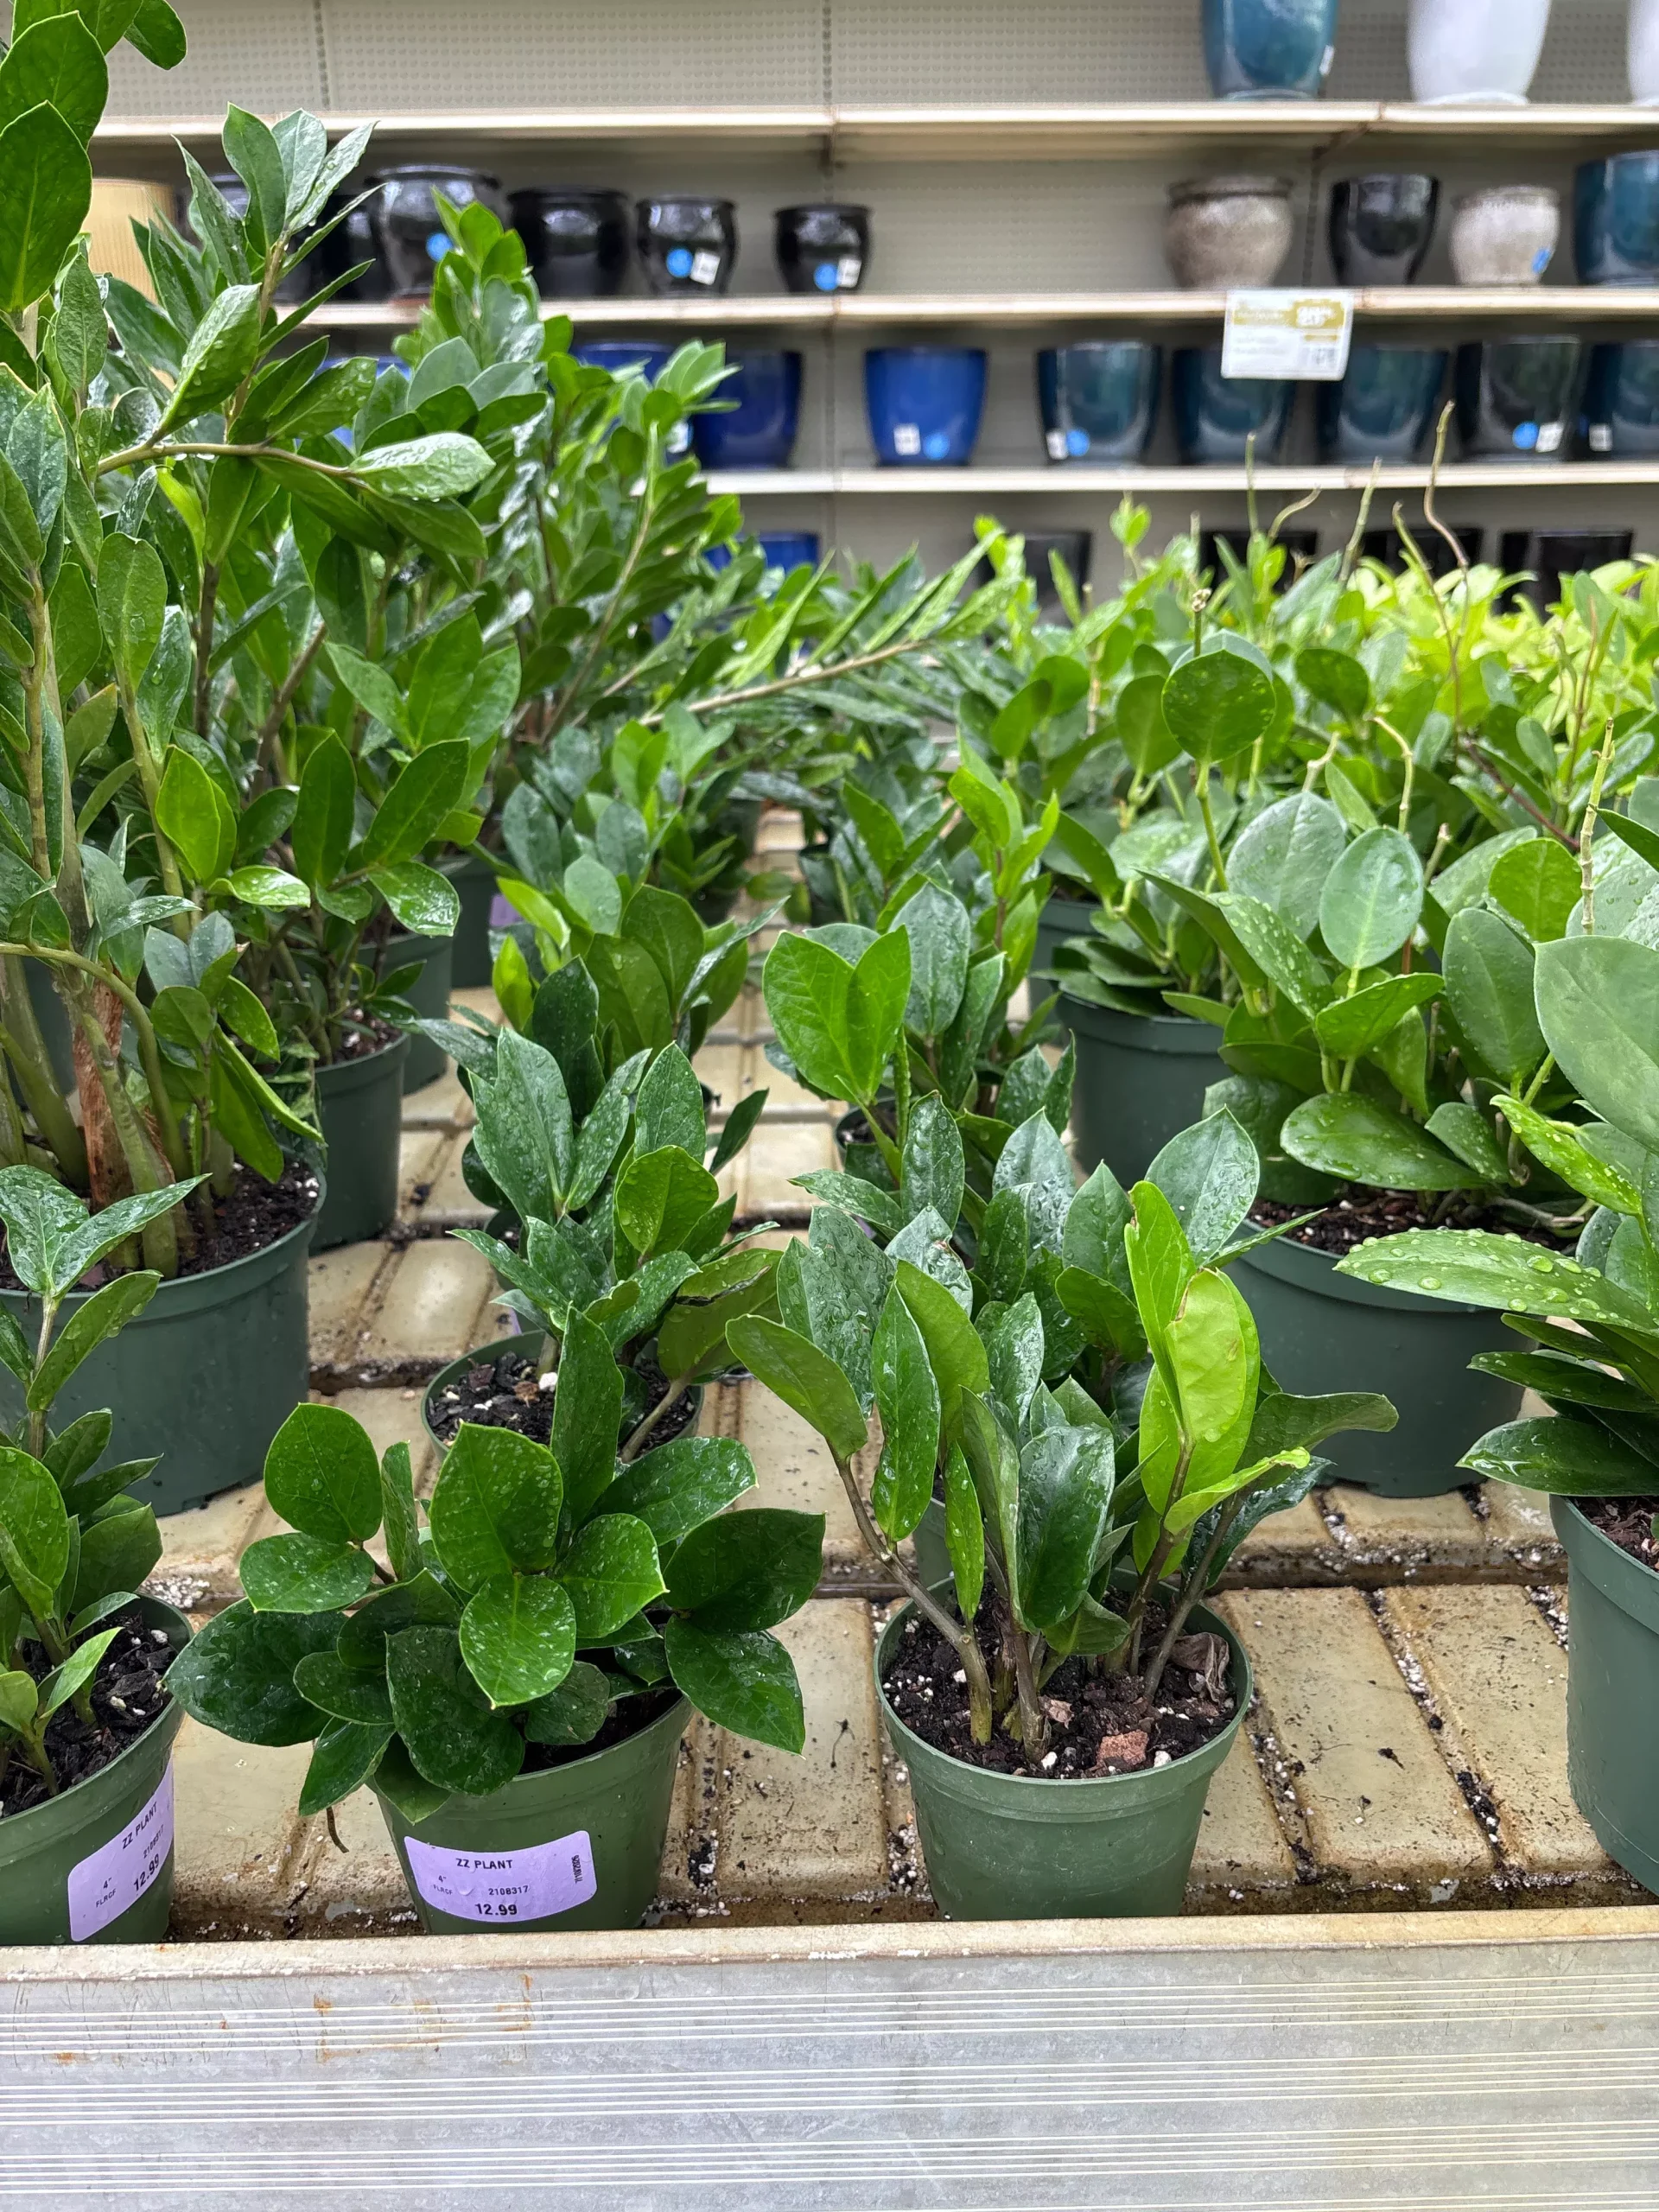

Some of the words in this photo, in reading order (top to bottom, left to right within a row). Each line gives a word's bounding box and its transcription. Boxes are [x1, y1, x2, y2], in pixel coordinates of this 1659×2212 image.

[122, 1833, 133, 1849] ZZ
[136, 1801, 157, 1836] PLANT
[455, 1858, 470, 1869] ZZ
[474, 1859, 513, 1870] PLANT
[133, 1853, 160, 1891] 12.99
[488, 1885, 529, 1896] 2108317
[95, 1889, 117, 1908] FLRCF
[475, 1904, 518, 1916] 12.99
